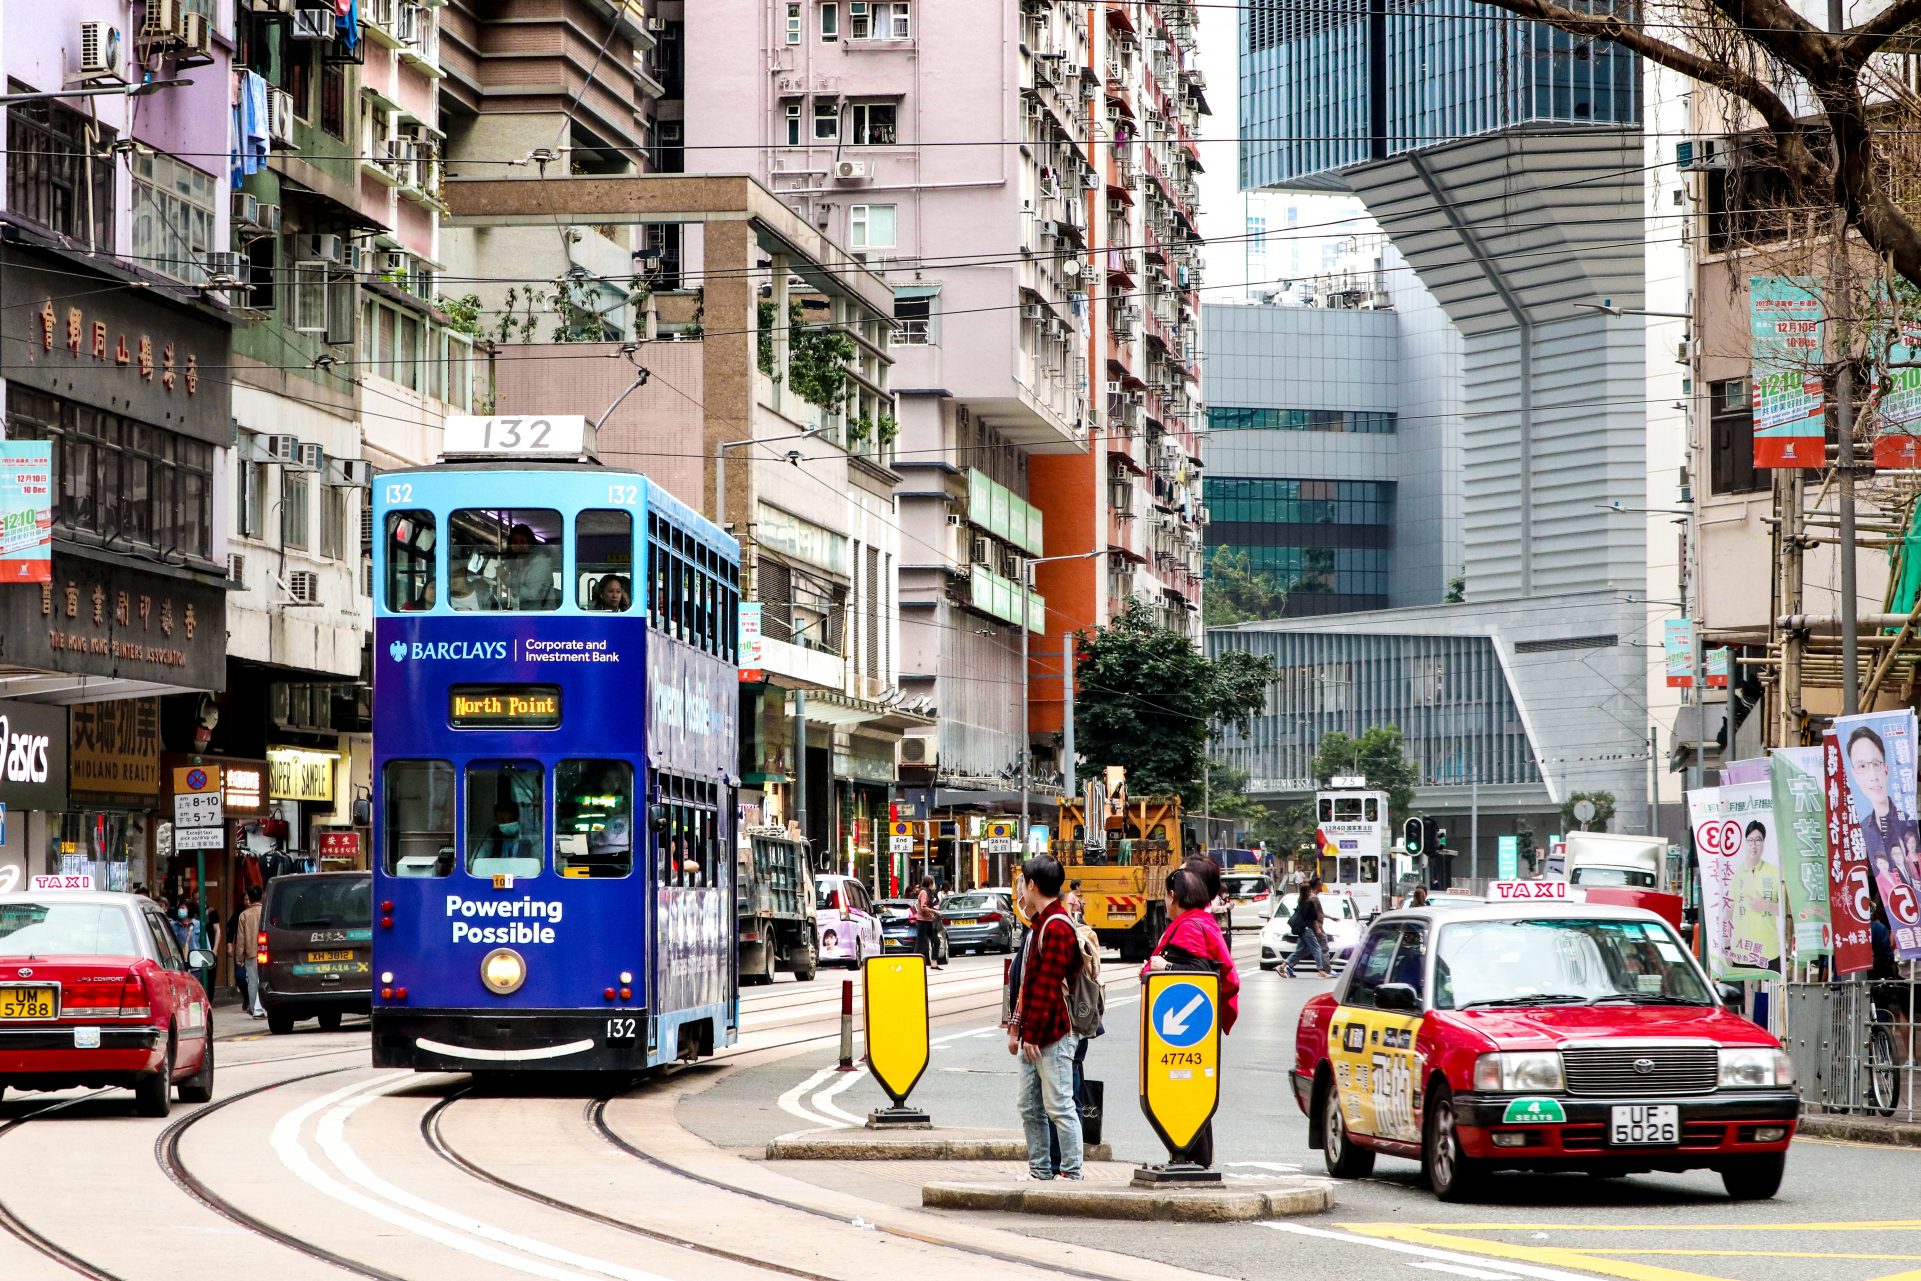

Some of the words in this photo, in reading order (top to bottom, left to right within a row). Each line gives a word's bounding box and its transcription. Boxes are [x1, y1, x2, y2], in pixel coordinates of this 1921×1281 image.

[1759, 370, 1803, 398] 1210
[483, 419, 552, 449] 132
[17, 474, 47, 482] 12月10日
[385, 483, 413, 503] 132
[608, 485, 638, 504] 132
[3, 508, 36, 530] 1210
[50, 631, 64, 649] THE
[68, 634, 87, 652] HONG
[90, 637, 108, 655] KONG
[145, 645, 187, 667] ASSOCIATION
[411, 641, 507, 660] BARCLAYS
[525, 638, 584, 652] Corporate
[586, 639, 607, 650] and
[525, 651, 590, 662] Investment
[592, 652, 620, 662] Bank
[455, 697, 502, 715] North
[509, 697, 555, 715] Point
[8, 733, 49, 783] asics
[74, 759, 118, 780] MIDLAND
[122, 763, 156, 782] REALTY
[270, 760, 291, 796] SUPER
[301, 763, 326, 797] SAMPLE
[193, 796, 219, 807] 8-10
[327, 836, 351, 845] 安生
[36, 876, 90, 888] TAXI
[1497, 883, 1565, 898] TAXI
[446, 895, 563, 923] Powering
[452, 921, 555, 944] Possible
[312, 952, 325, 961] XH
[327, 951, 349, 960] 3812
[15, 989, 38, 1003] UM
[4, 1003, 49, 1016] 5788
[606, 1018, 636, 1038] 132
[1160, 1052, 1202, 1065] 47743
[1527, 1101, 1541, 1113] 4
[1630, 1106, 1658, 1123] UF
[1616, 1123, 1674, 1142] 5026
